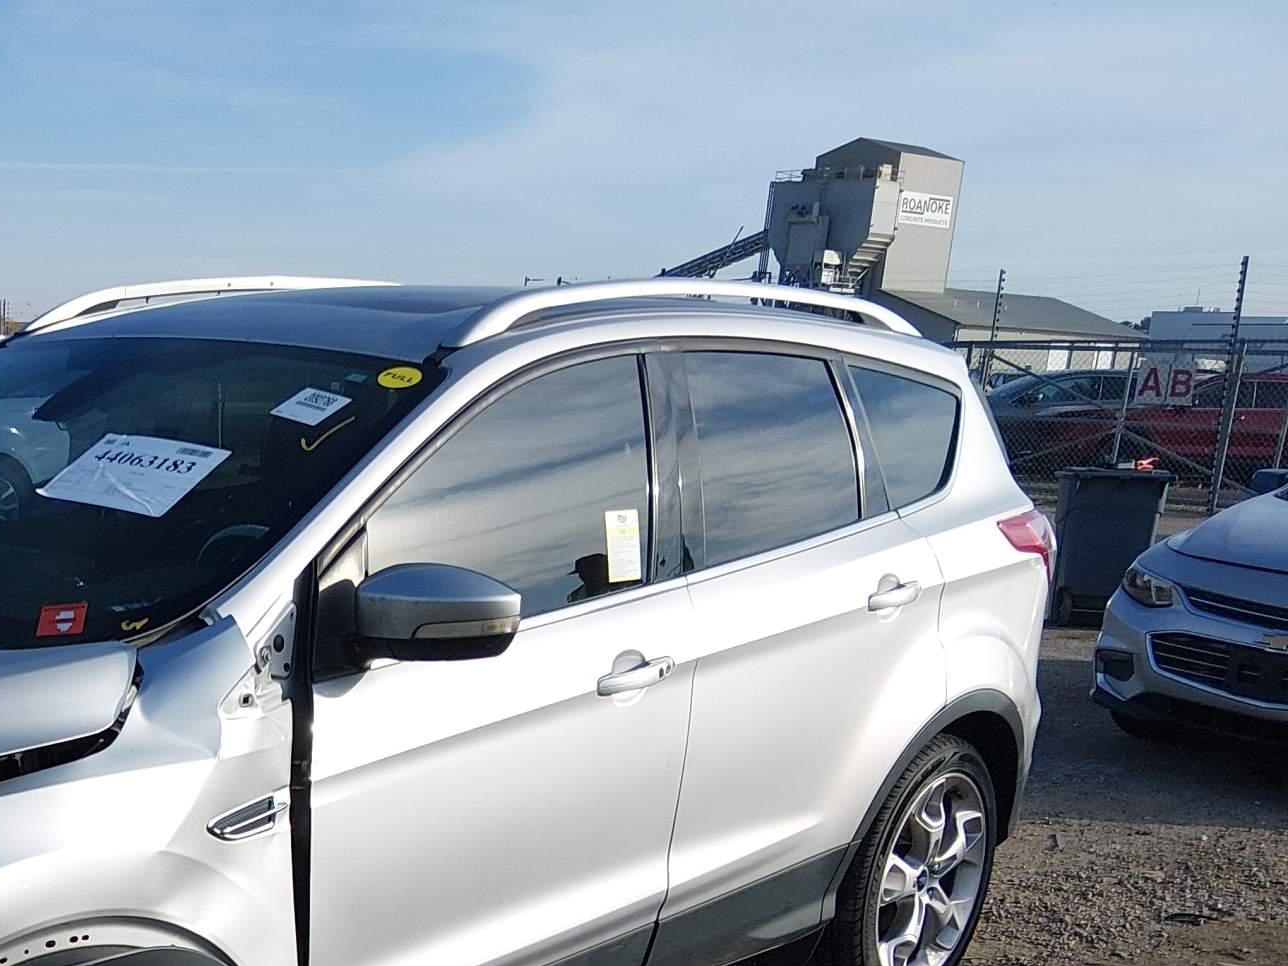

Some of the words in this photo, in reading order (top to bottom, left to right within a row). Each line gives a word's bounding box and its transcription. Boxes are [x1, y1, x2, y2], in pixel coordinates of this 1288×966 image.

[902, 197, 951, 215] ROANOKE
[383, 371, 414, 384] FULL
[94, 449, 197, 475] 44063183
